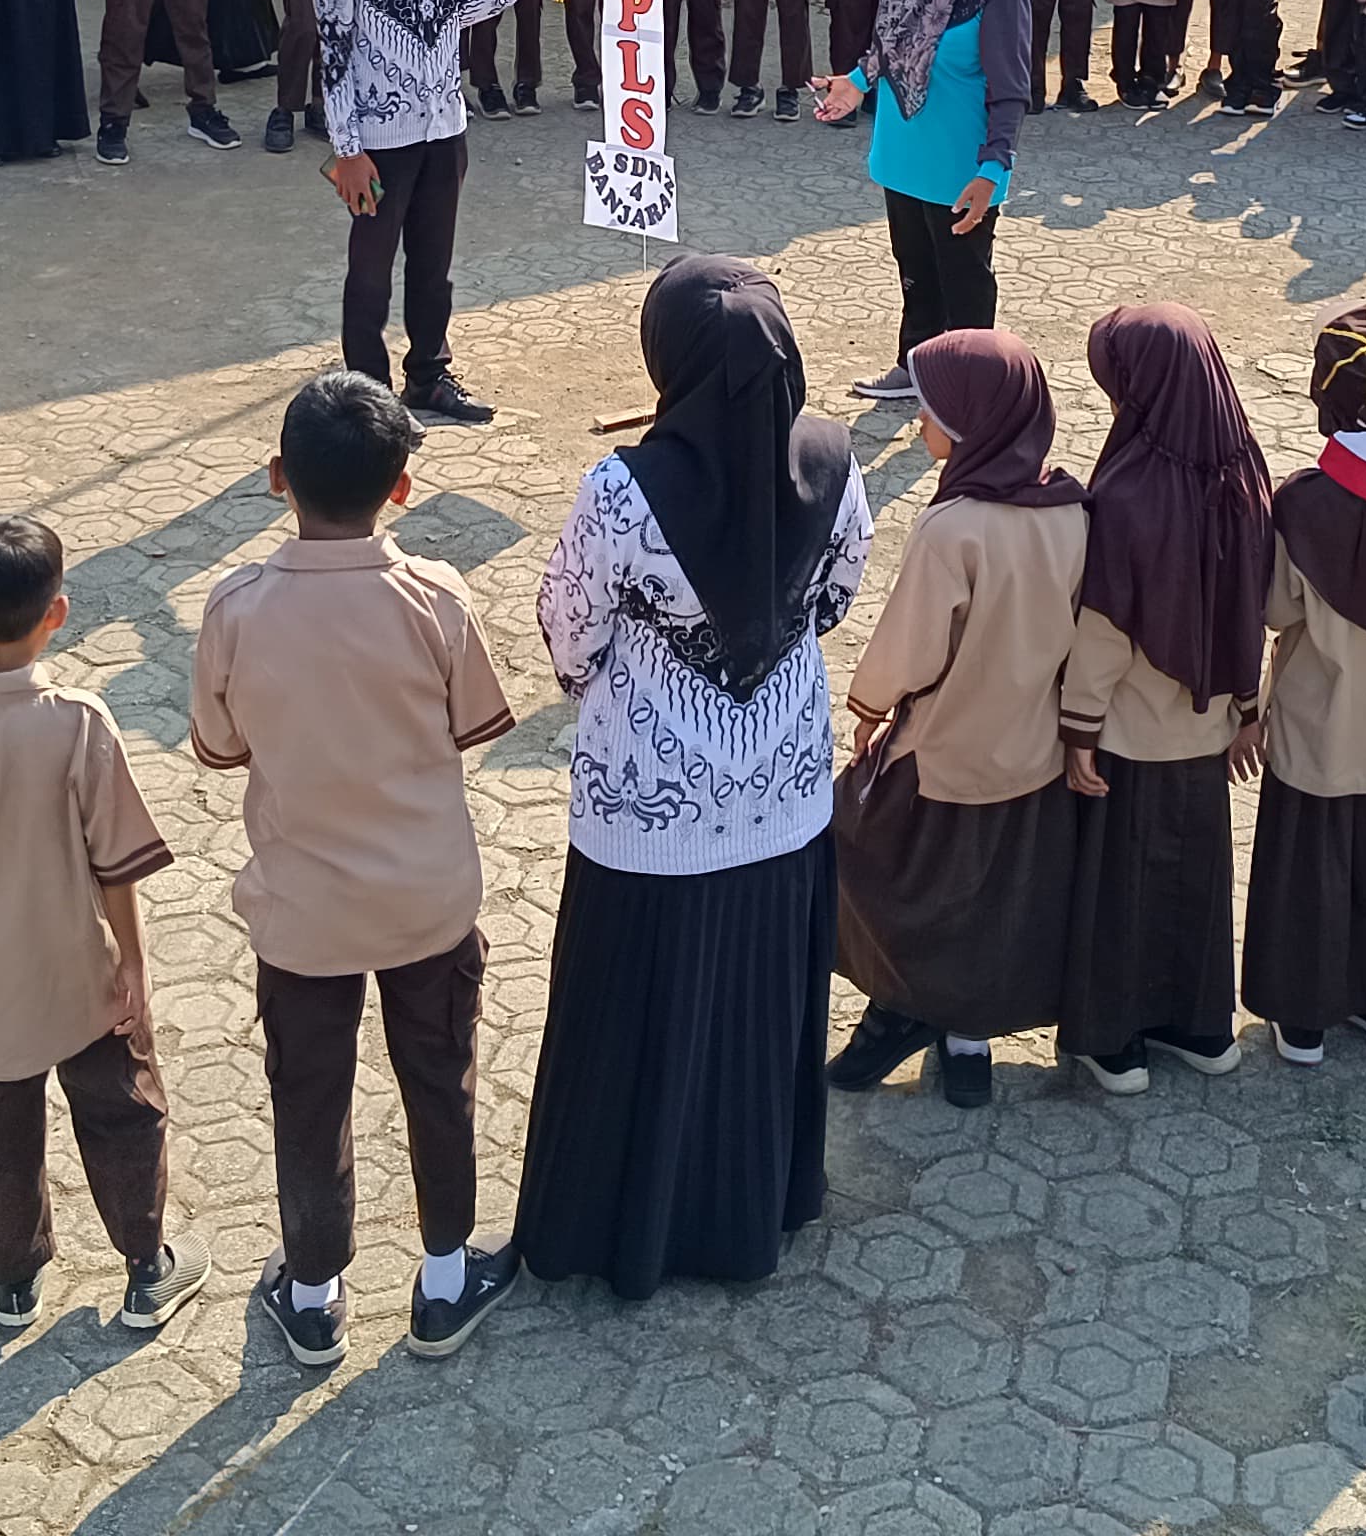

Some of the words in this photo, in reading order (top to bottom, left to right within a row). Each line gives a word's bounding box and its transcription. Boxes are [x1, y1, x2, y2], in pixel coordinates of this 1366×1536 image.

[613, 152, 662, 185] SDN
[586, 151, 675, 231] BANJARAN
[629, 180, 643, 202] 4
